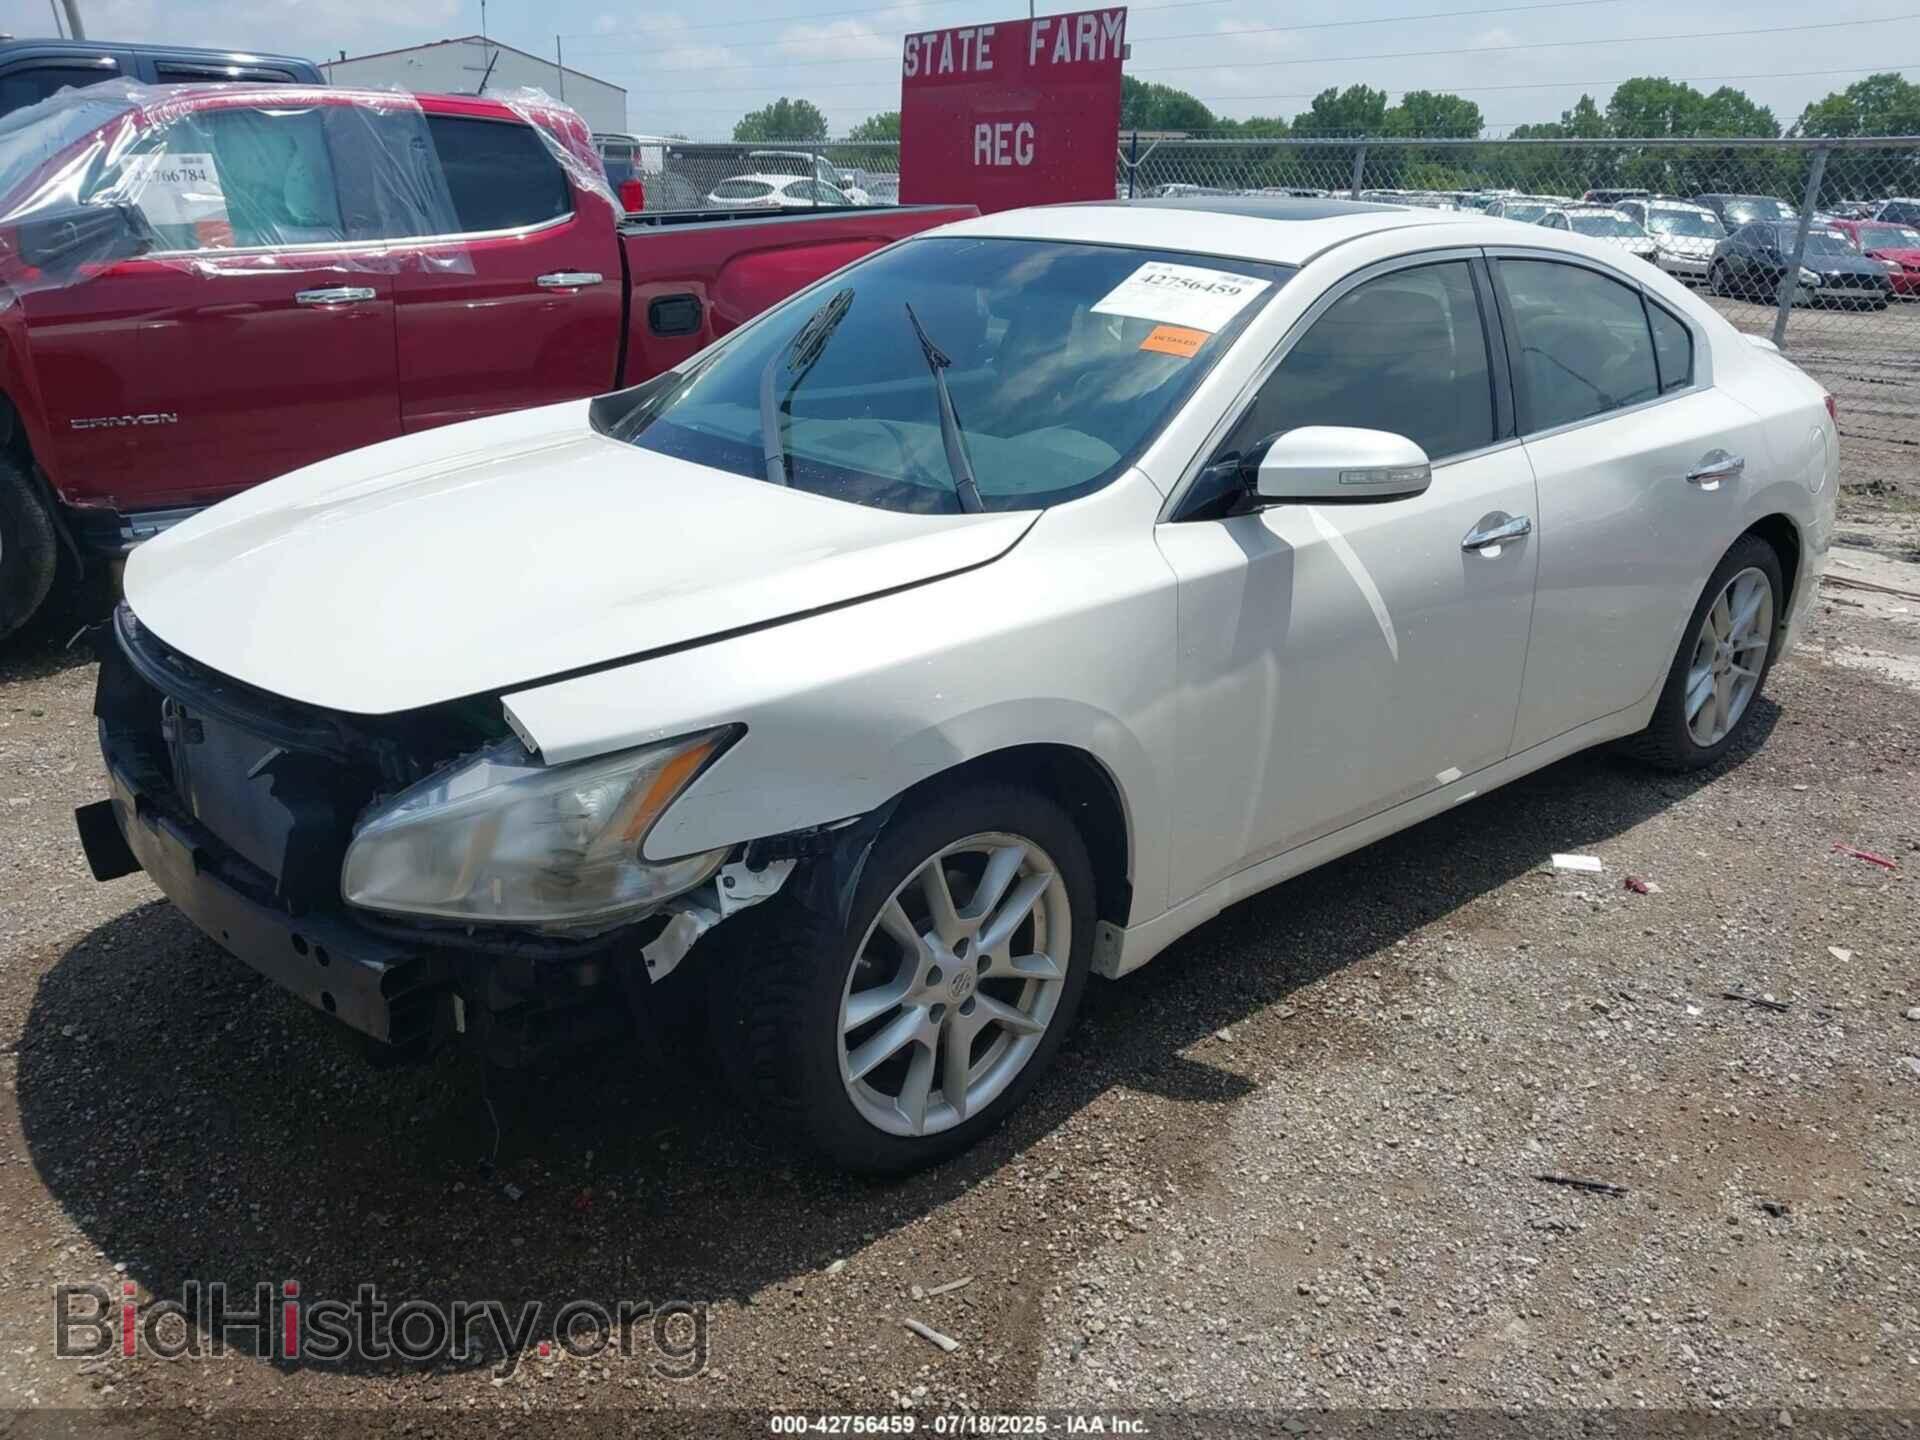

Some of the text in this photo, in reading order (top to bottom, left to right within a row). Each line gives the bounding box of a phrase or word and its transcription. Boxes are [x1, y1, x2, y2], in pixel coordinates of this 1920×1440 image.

[904, 10, 1124, 77] STATE FARM
[974, 122, 1035, 166] REG
[1141, 273, 1242, 296] 42756459
[70, 412, 178, 429] CANYON
